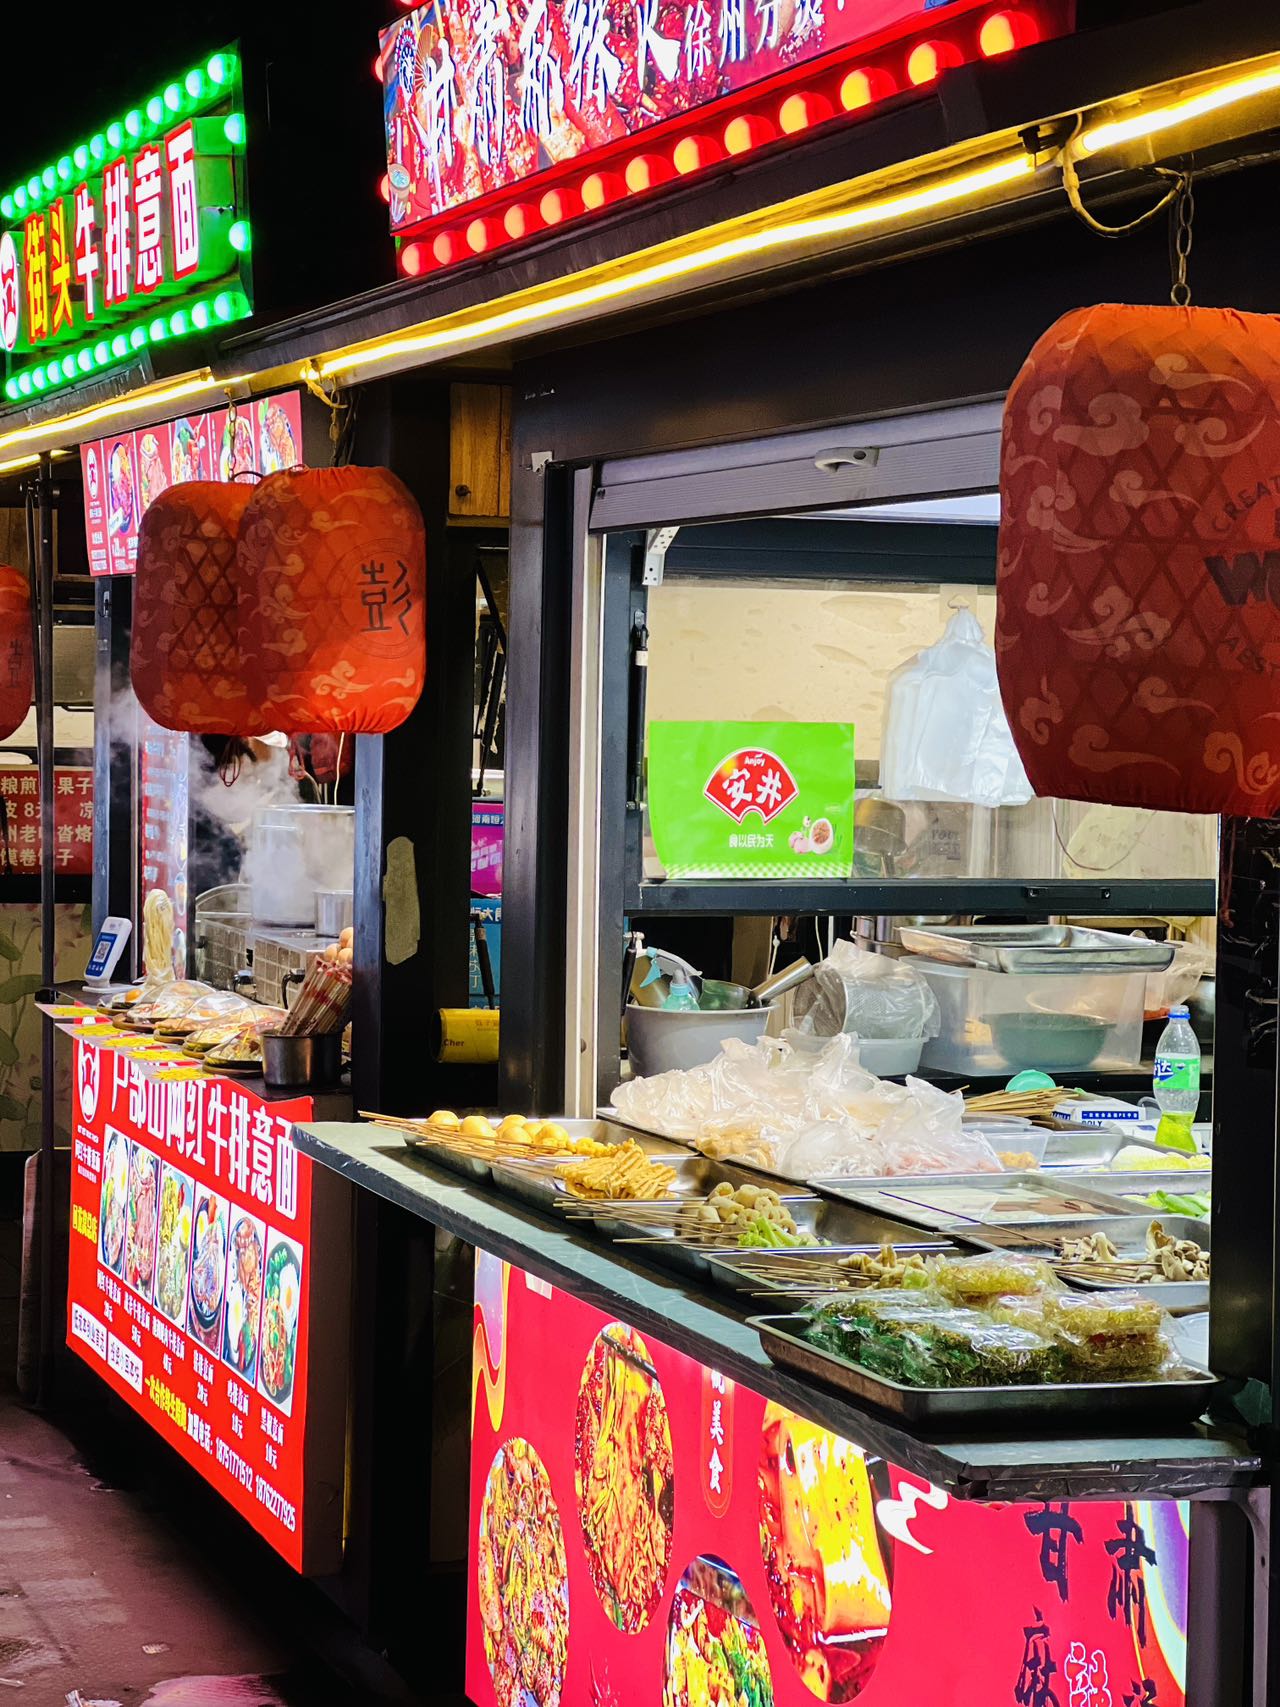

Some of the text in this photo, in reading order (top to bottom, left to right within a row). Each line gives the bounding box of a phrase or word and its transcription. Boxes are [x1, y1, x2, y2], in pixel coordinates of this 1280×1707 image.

[25, 119, 199, 344] 街头牛排意面
[744, 752, 765, 767] Anjoy
[0, 776, 94, 795] 粮煎果子
[722, 768, 782, 809] 安井
[1, 848, 74, 867] 馍卷子
